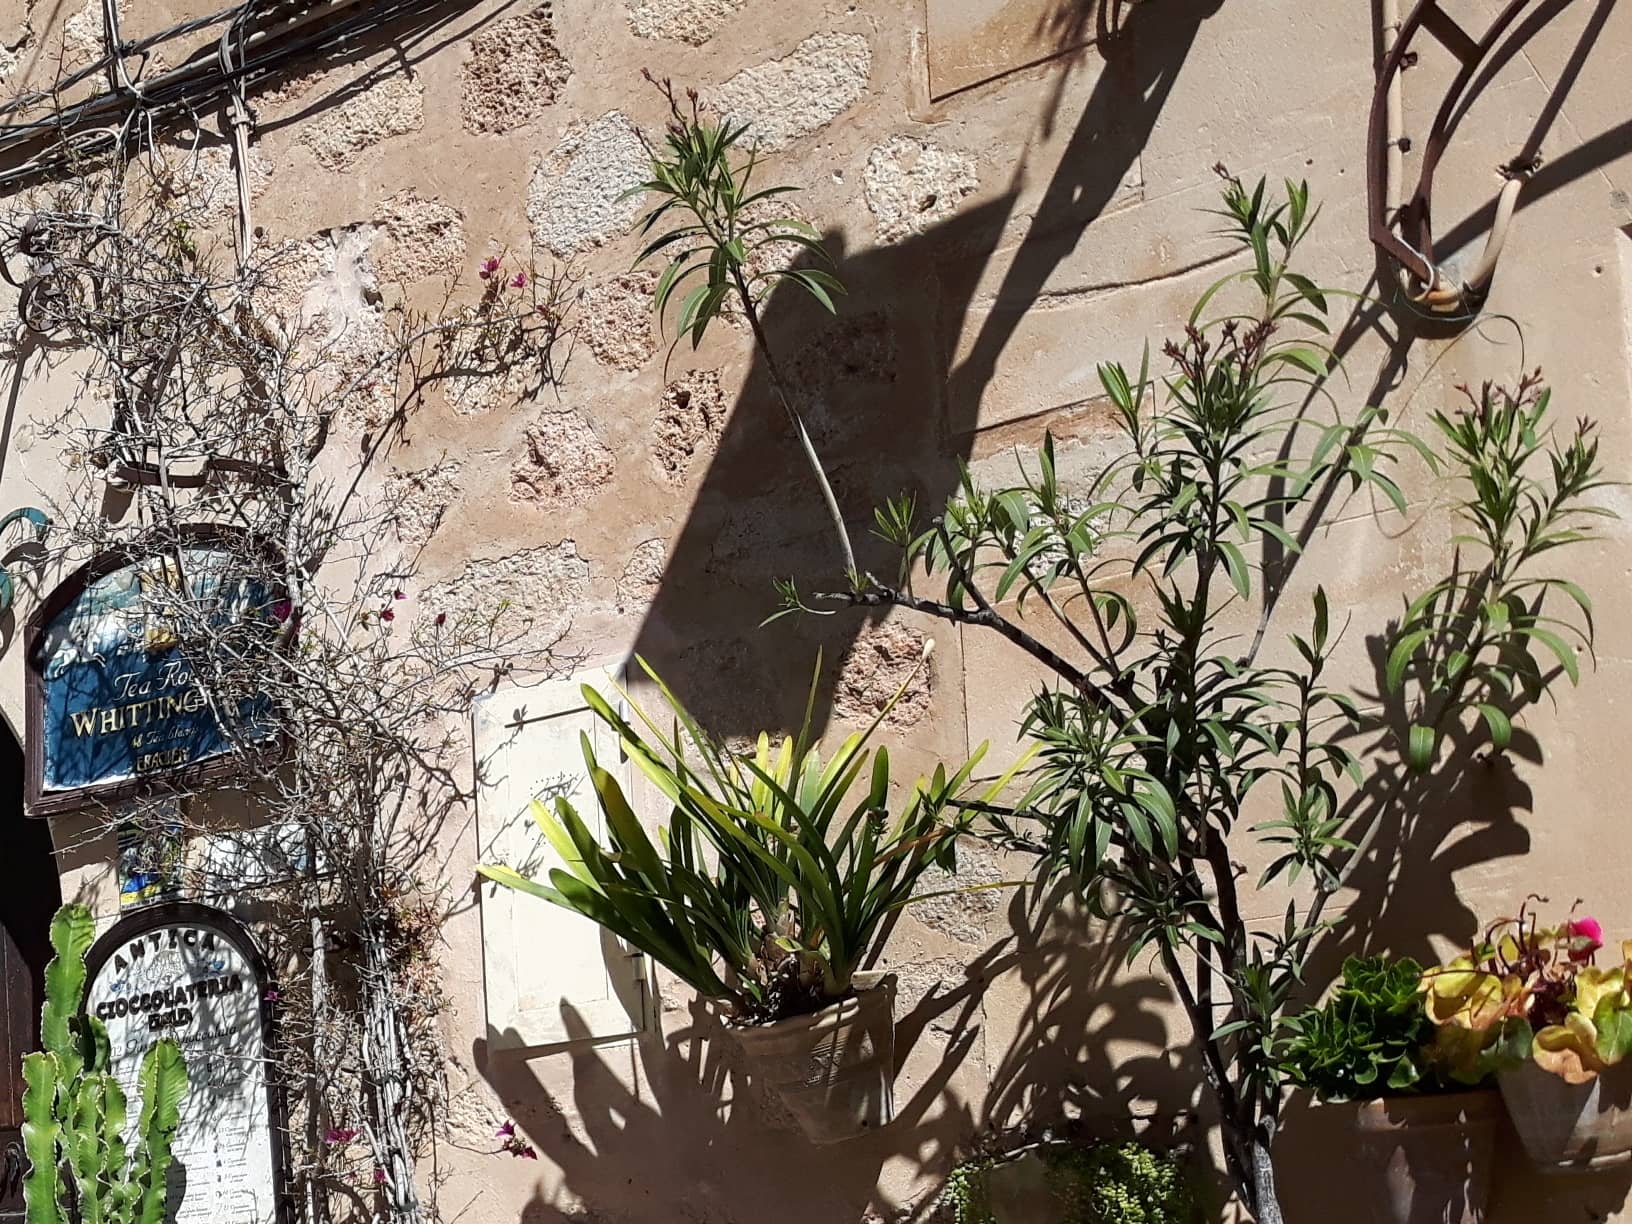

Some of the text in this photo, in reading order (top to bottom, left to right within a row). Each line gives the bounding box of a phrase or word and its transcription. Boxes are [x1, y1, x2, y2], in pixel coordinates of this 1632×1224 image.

[113, 672, 151, 700] Tea
[70, 688, 210, 738] WHITTING
[113, 929, 216, 975] ANTICA
[96, 974, 243, 1021] CIOCCOLATERIA
